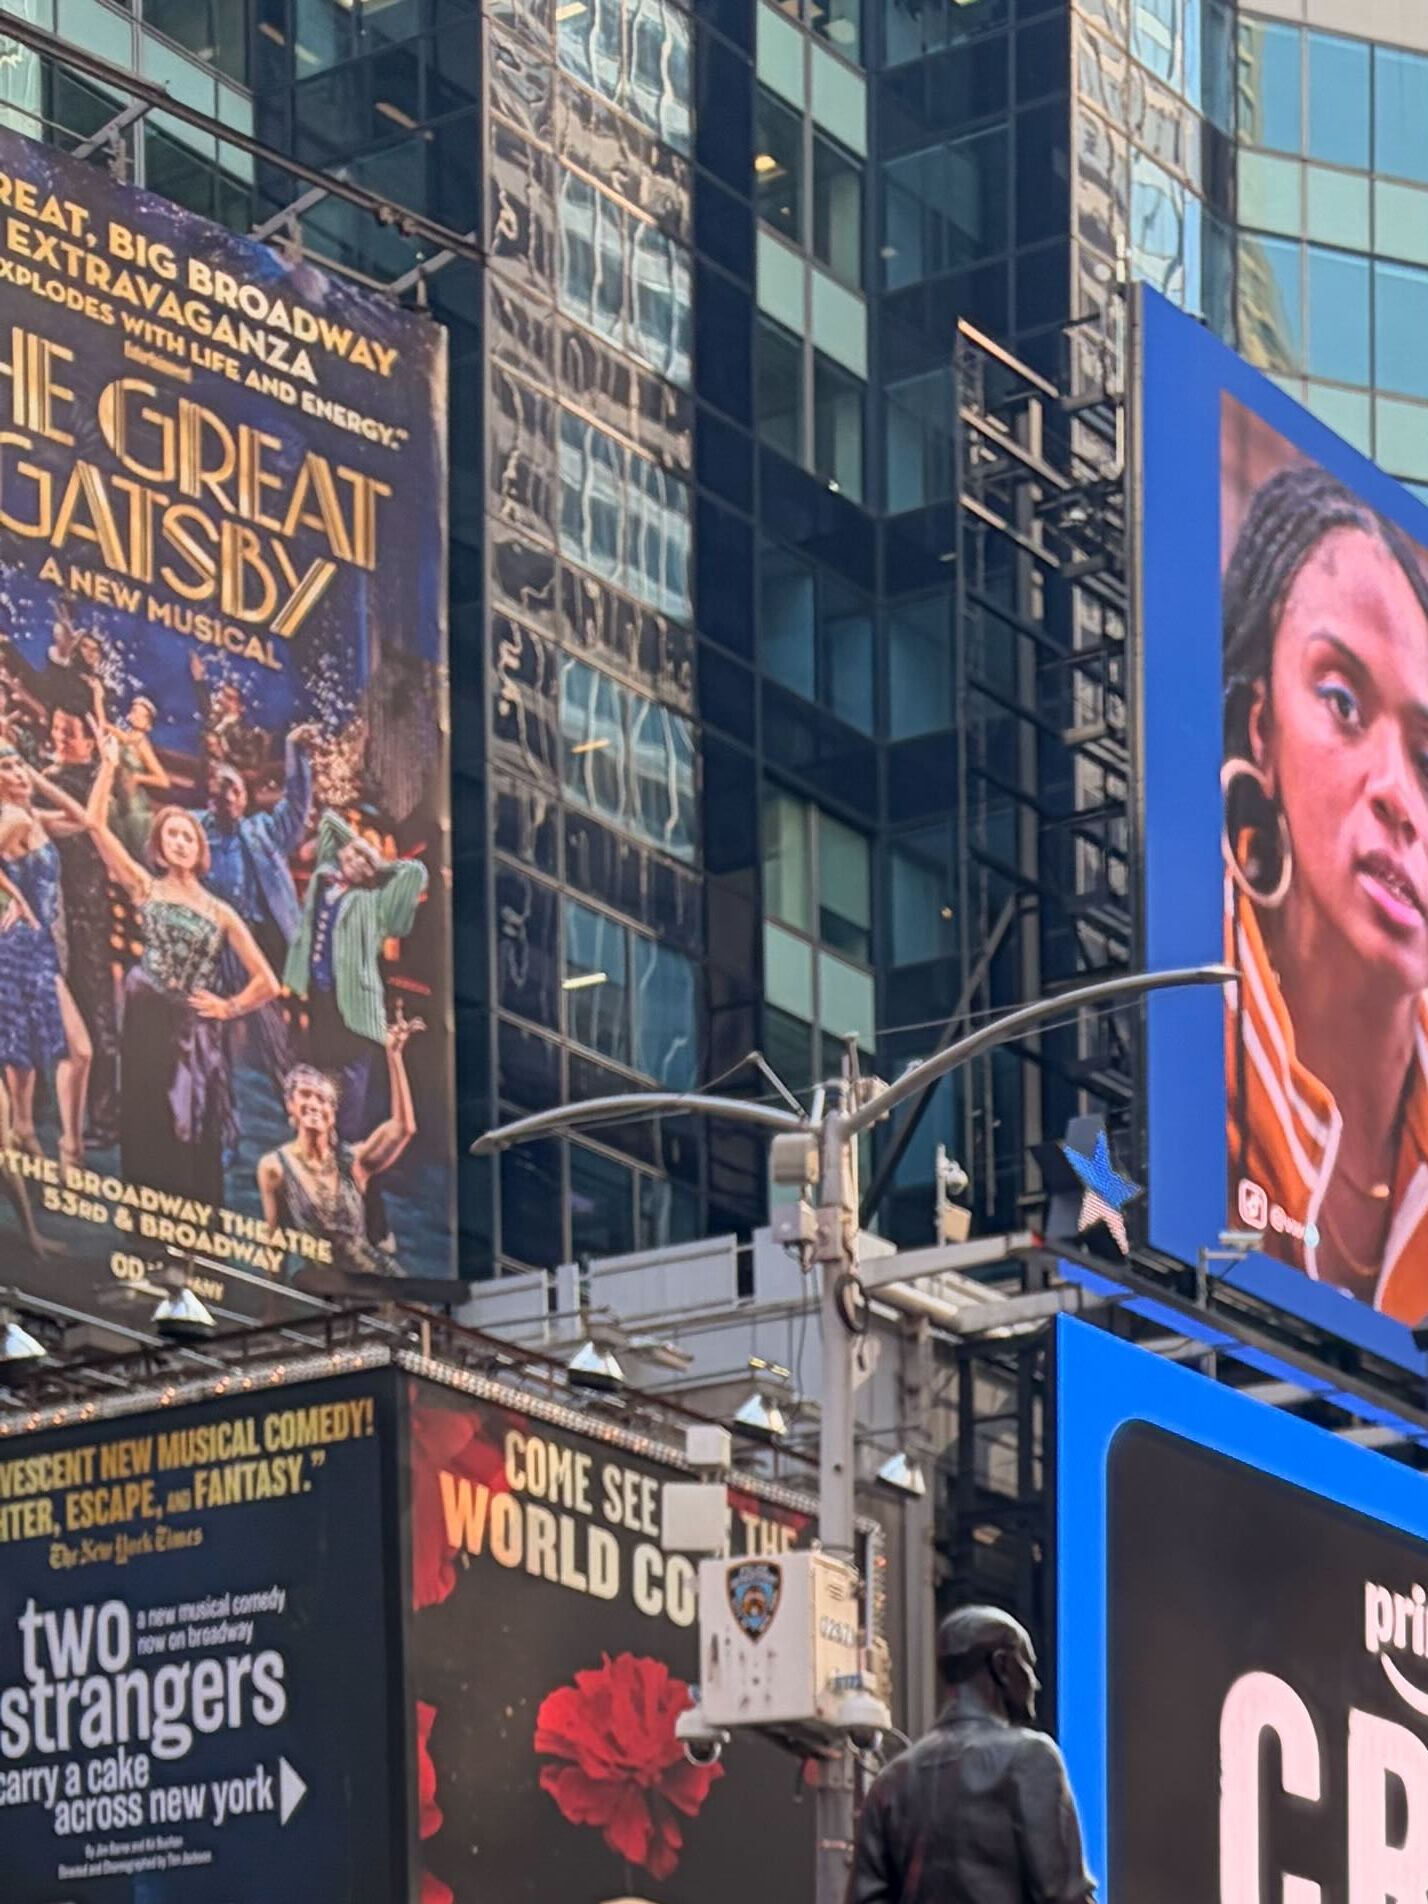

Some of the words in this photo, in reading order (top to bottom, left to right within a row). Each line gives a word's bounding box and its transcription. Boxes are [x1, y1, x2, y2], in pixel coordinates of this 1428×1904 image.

[7, 216, 319, 386] EXTRAVAGANZA
[109, 221, 177, 281] BIG
[189, 258, 400, 378] BROADWAY
[121, 311, 186, 357] WITH
[191, 342, 241, 381] LIFE
[245, 368, 299, 407] AND
[98, 378, 392, 571] GREAT
[0, 431, 337, 638] GATSBY
[39, 557, 63, 587] A
[70, 566, 142, 612] NEW
[148, 598, 285, 672] MUSICAL
[8, 1151, 60, 1185] THE
[65, 1165, 213, 1227] BROADWAY
[219, 1208, 334, 1265] THEATRE
[43, 1186, 109, 1225] 53RD
[113, 1206, 134, 1232] &
[139, 1212, 285, 1274] BROADWAY
[100, 1433, 154, 1481] NEW
[157, 1416, 262, 1471] MUSICAL
[263, 1397, 375, 1453] COMEDY!
[505, 1429, 594, 1515] COME
[602, 1462, 662, 1538] SEE
[65, 1478, 164, 1531] ESCAPE,
[438, 1470, 621, 1601] WORLD
[18, 1596, 131, 1682] two
[136, 1610, 146, 1629] a
[148, 1604, 178, 1626] new
[178, 1591, 231, 1624] musical
[232, 1584, 287, 1617] comedy
[137, 1633, 167, 1656] now
[168, 1631, 187, 1652] on
[188, 1618, 255, 1648] broadway
[0, 1649, 288, 1761] strangers
[0, 1761, 60, 1810] carry
[64, 1765, 82, 1798] a
[88, 1743, 151, 1793] cake
[54, 1788, 144, 1837] across
[149, 1778, 207, 1824] new
[212, 1763, 275, 1827] york
